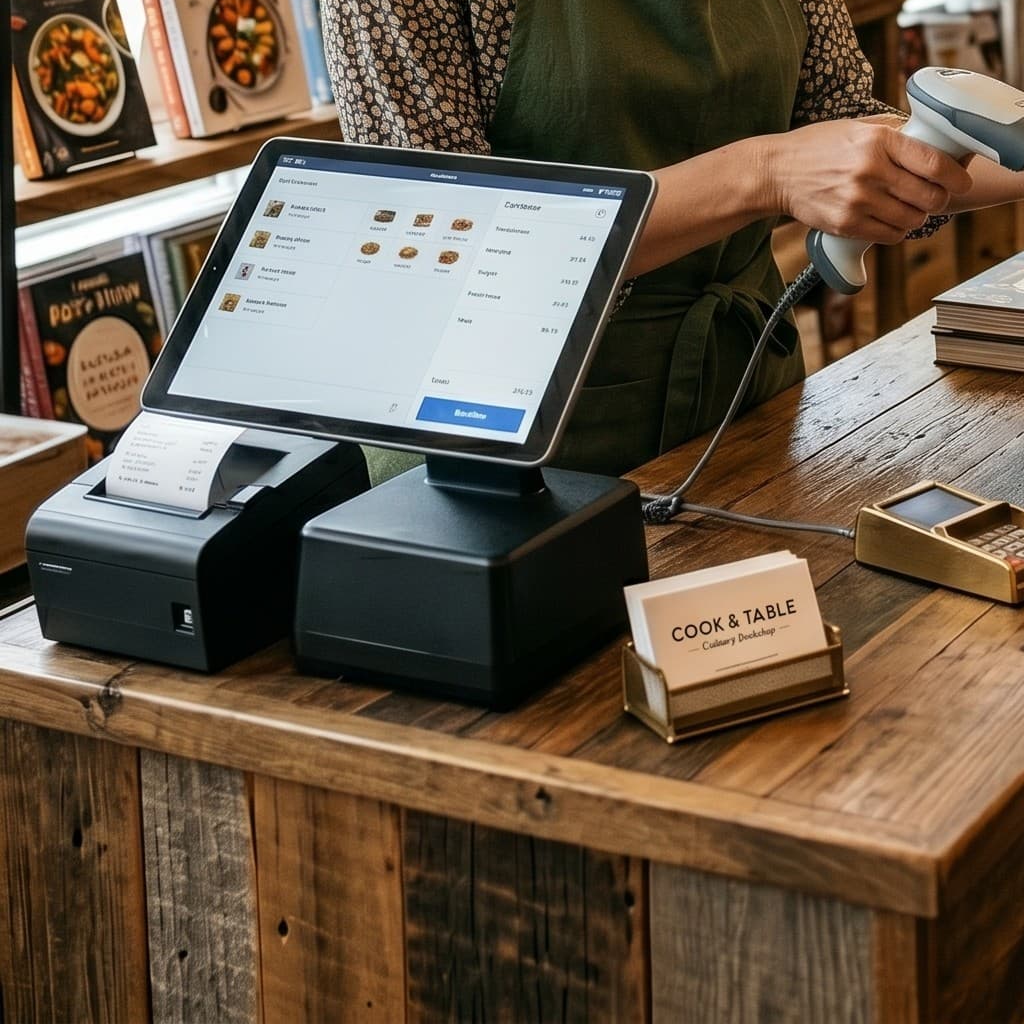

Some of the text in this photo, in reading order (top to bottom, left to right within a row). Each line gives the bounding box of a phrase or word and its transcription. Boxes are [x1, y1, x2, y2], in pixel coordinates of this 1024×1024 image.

[671, 598, 797, 642] COOK & TABLE
